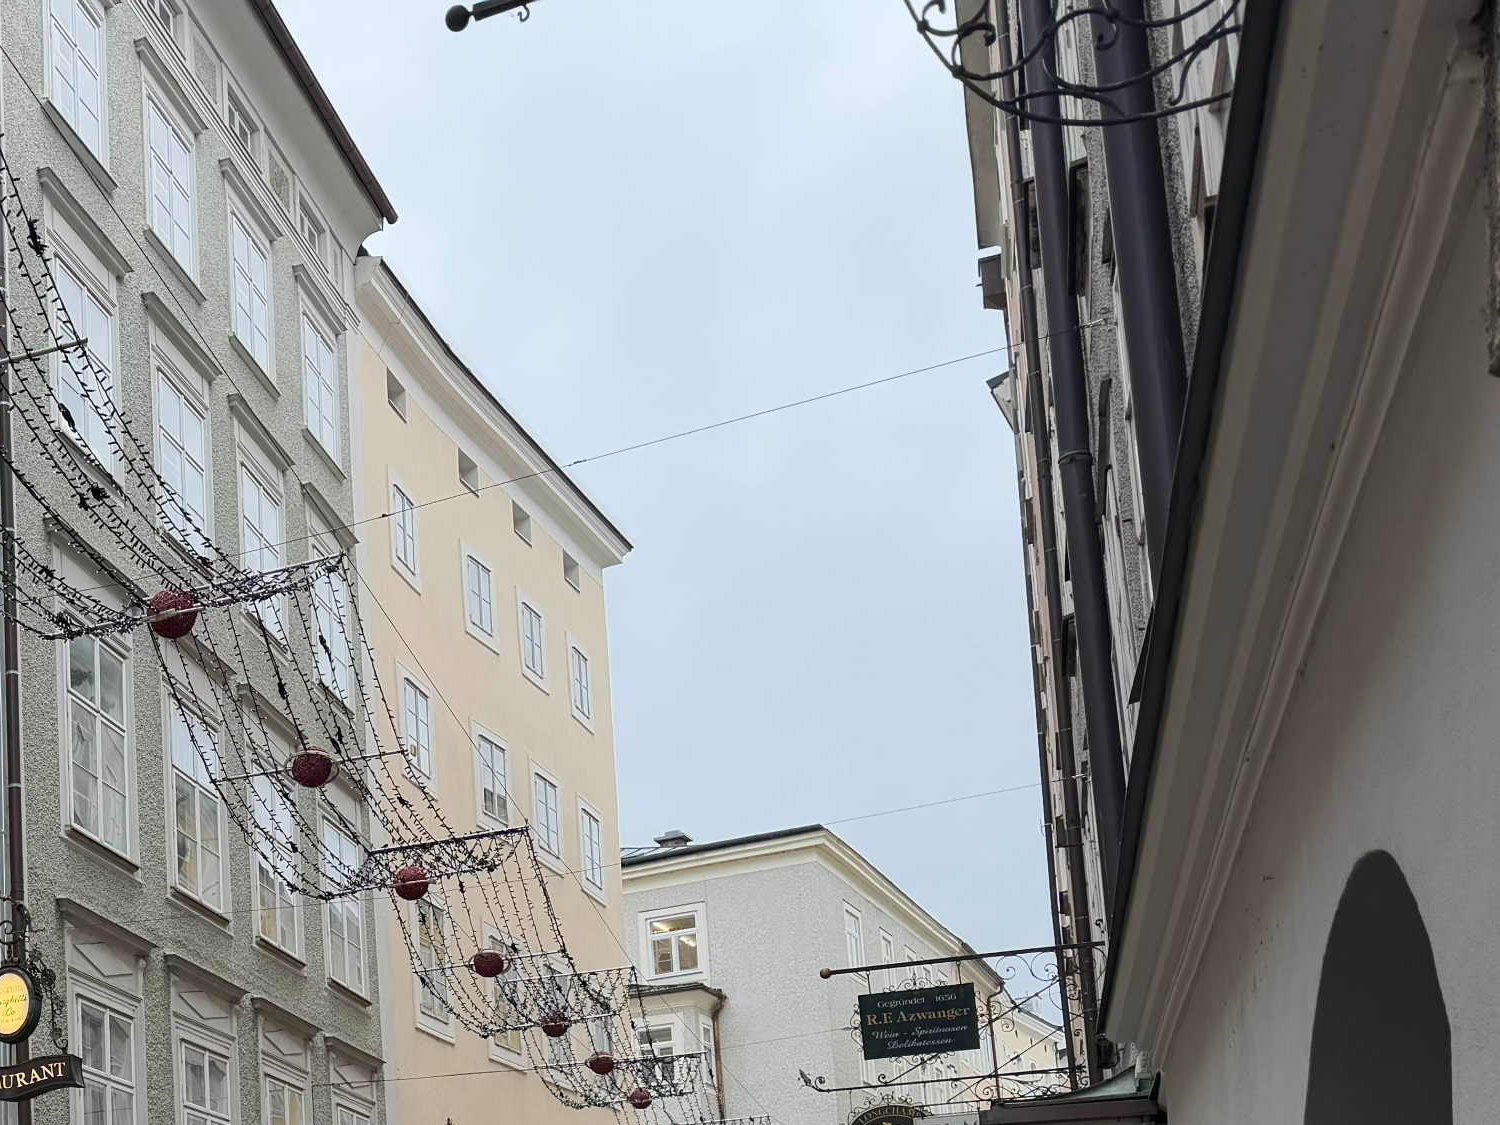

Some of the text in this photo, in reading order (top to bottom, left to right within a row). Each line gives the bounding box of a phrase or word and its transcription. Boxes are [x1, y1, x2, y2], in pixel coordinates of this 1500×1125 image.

[877, 993, 957, 1009] Gegründet 1656
[896, 1007, 970, 1023] Azwanger
[871, 1031, 900, 1040] Wein
[911, 1025, 969, 1038] Spirituosen
[887, 1037, 953, 1050] Delikatessen
